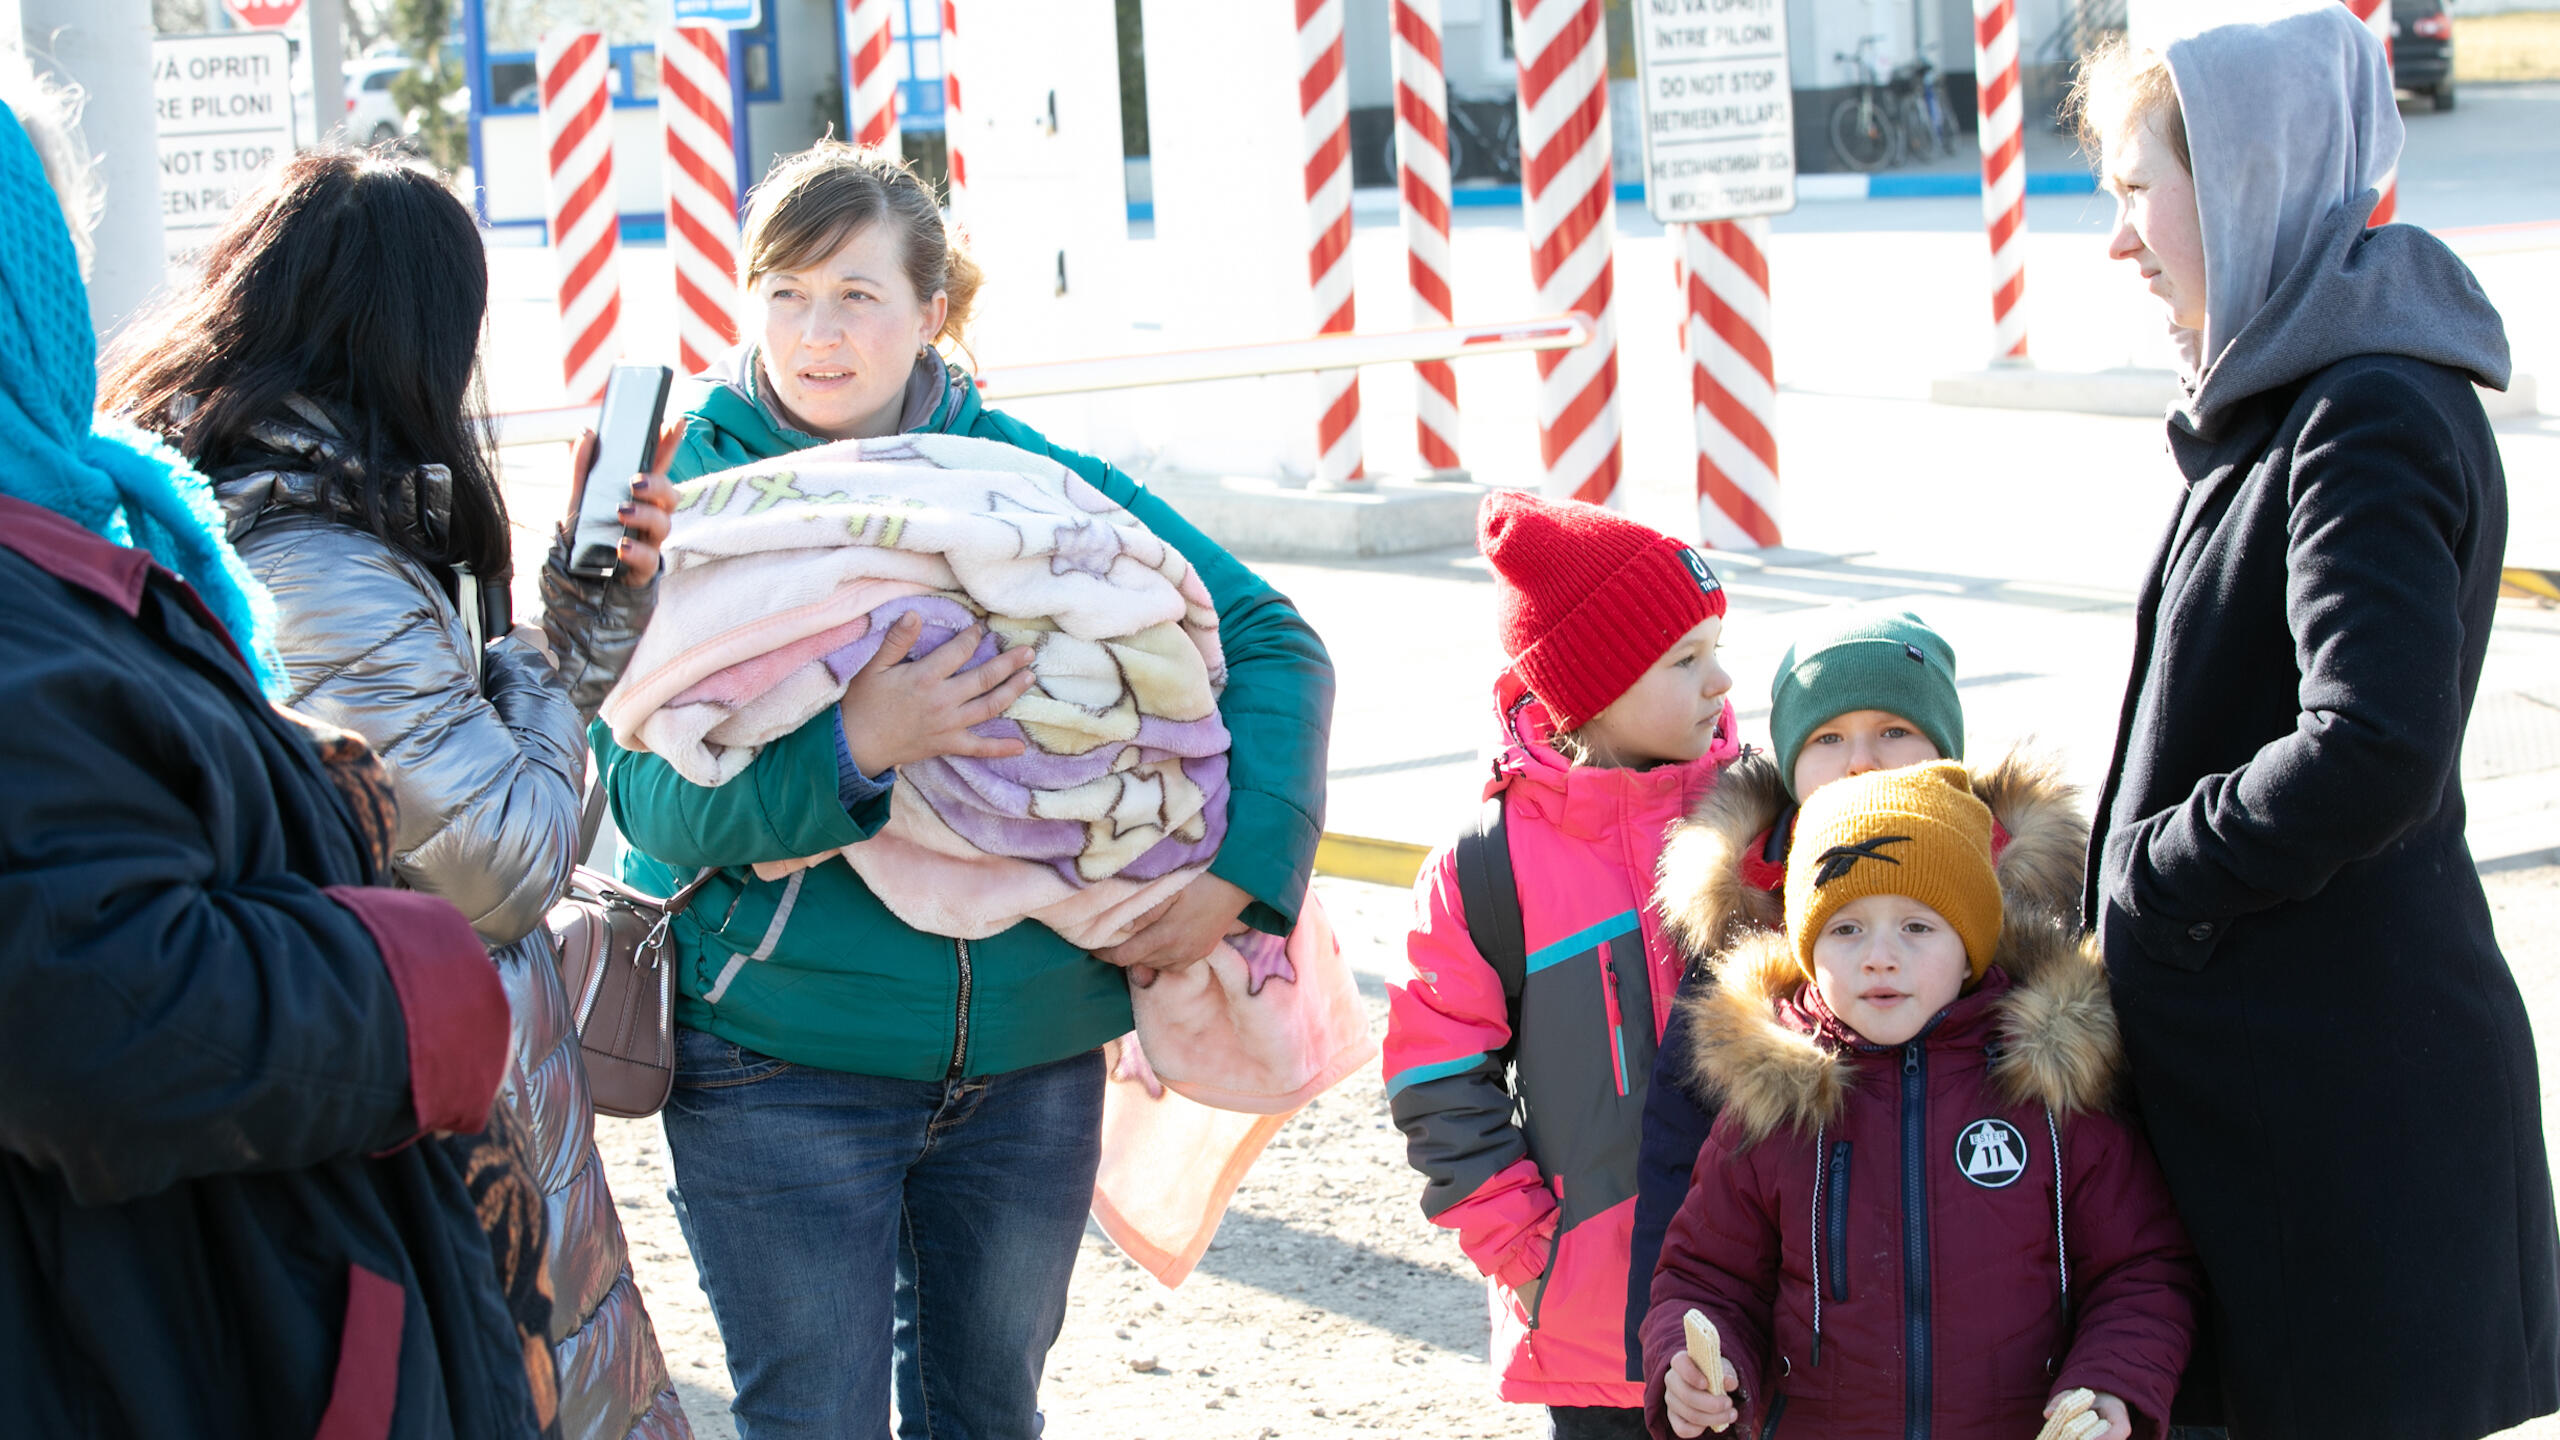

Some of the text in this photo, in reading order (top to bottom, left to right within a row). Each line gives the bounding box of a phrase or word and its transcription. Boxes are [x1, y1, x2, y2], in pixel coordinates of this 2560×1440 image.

[1659, 69, 1775, 99] DO NOT STOP
[192, 93, 273, 118] PILONI
[1651, 108, 1721, 133] BETWEEN
[1972, 1132, 2006, 1144] ESTER
[1982, 1145, 2003, 1168] 11
